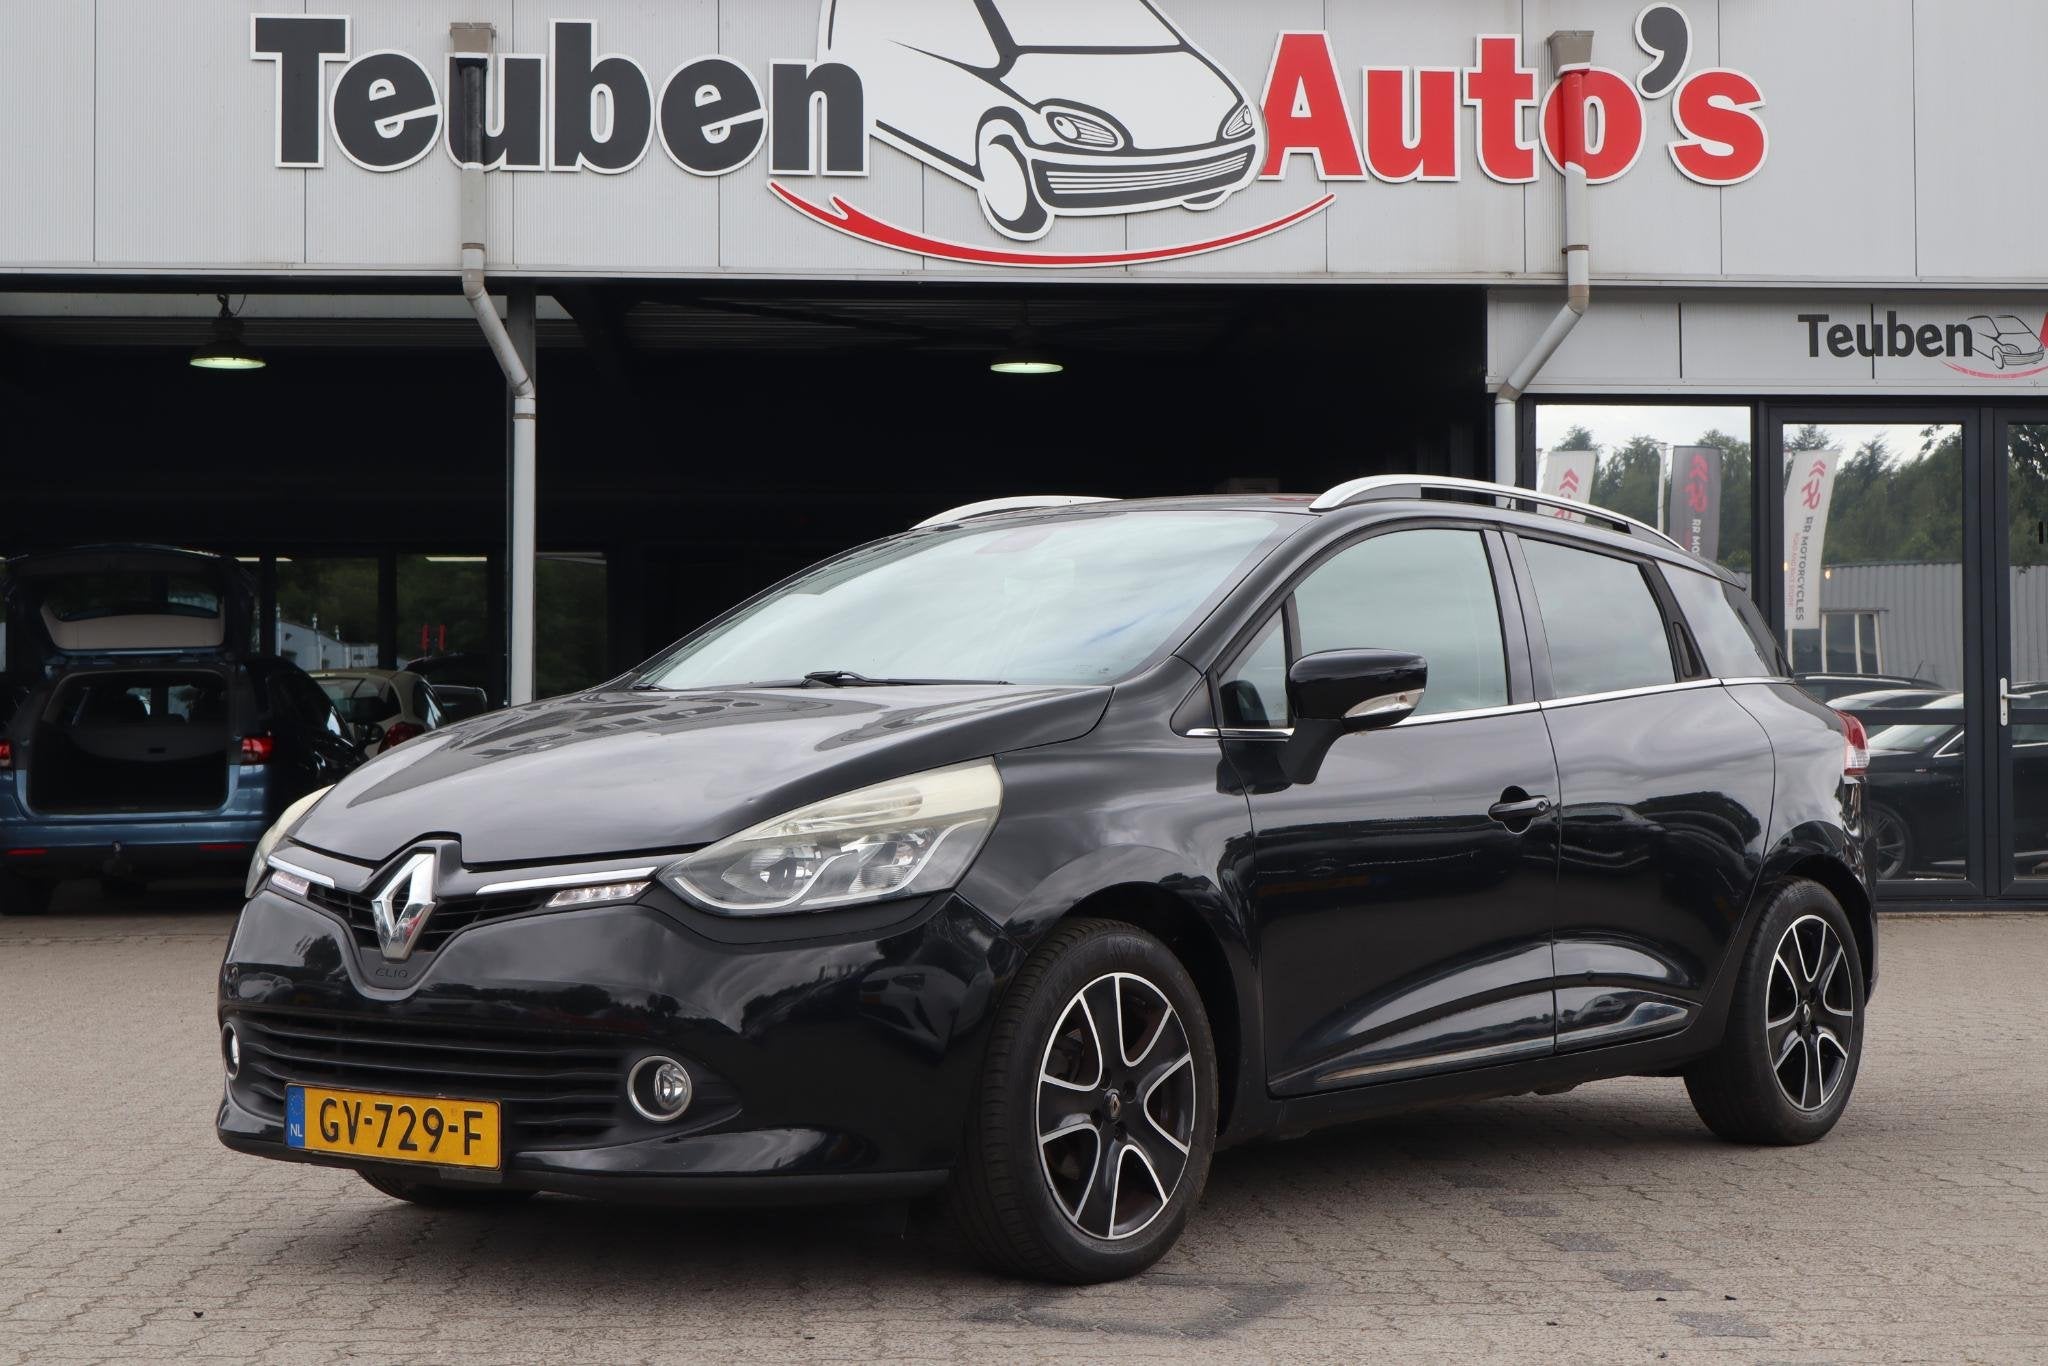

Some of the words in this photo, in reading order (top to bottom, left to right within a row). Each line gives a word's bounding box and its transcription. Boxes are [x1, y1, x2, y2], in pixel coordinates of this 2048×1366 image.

[251, 15, 867, 176] Teuben
[1259, 3, 1768, 185] Auto's
[1798, 311, 1973, 358] Teuben
[1795, 536, 1808, 621] MOTORCYCLES
[290, 1124, 303, 1138] NL
[319, 1097, 484, 1156] GV-729-F
